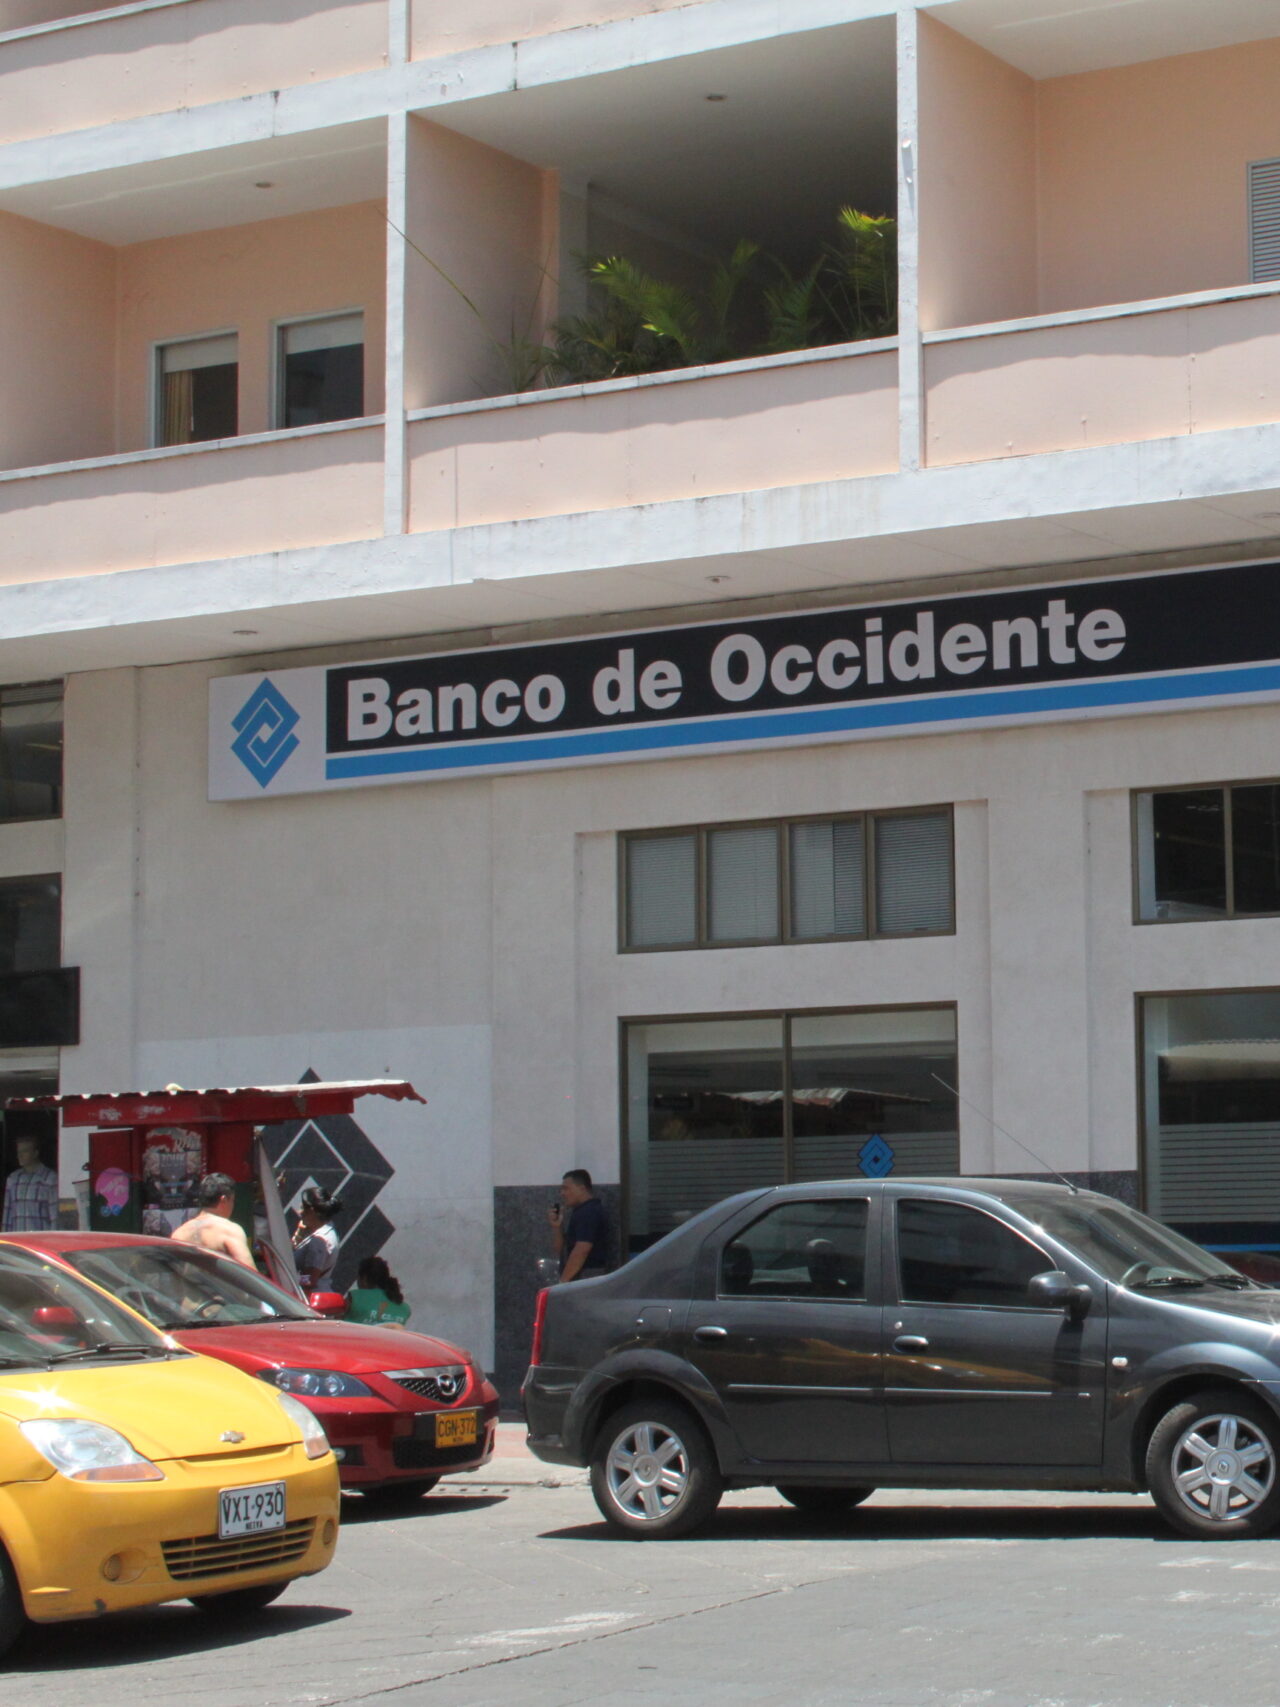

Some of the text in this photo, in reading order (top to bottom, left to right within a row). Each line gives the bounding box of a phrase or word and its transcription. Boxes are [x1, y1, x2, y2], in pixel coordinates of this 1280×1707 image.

[347, 600, 1127, 742] Banco de Occidente
